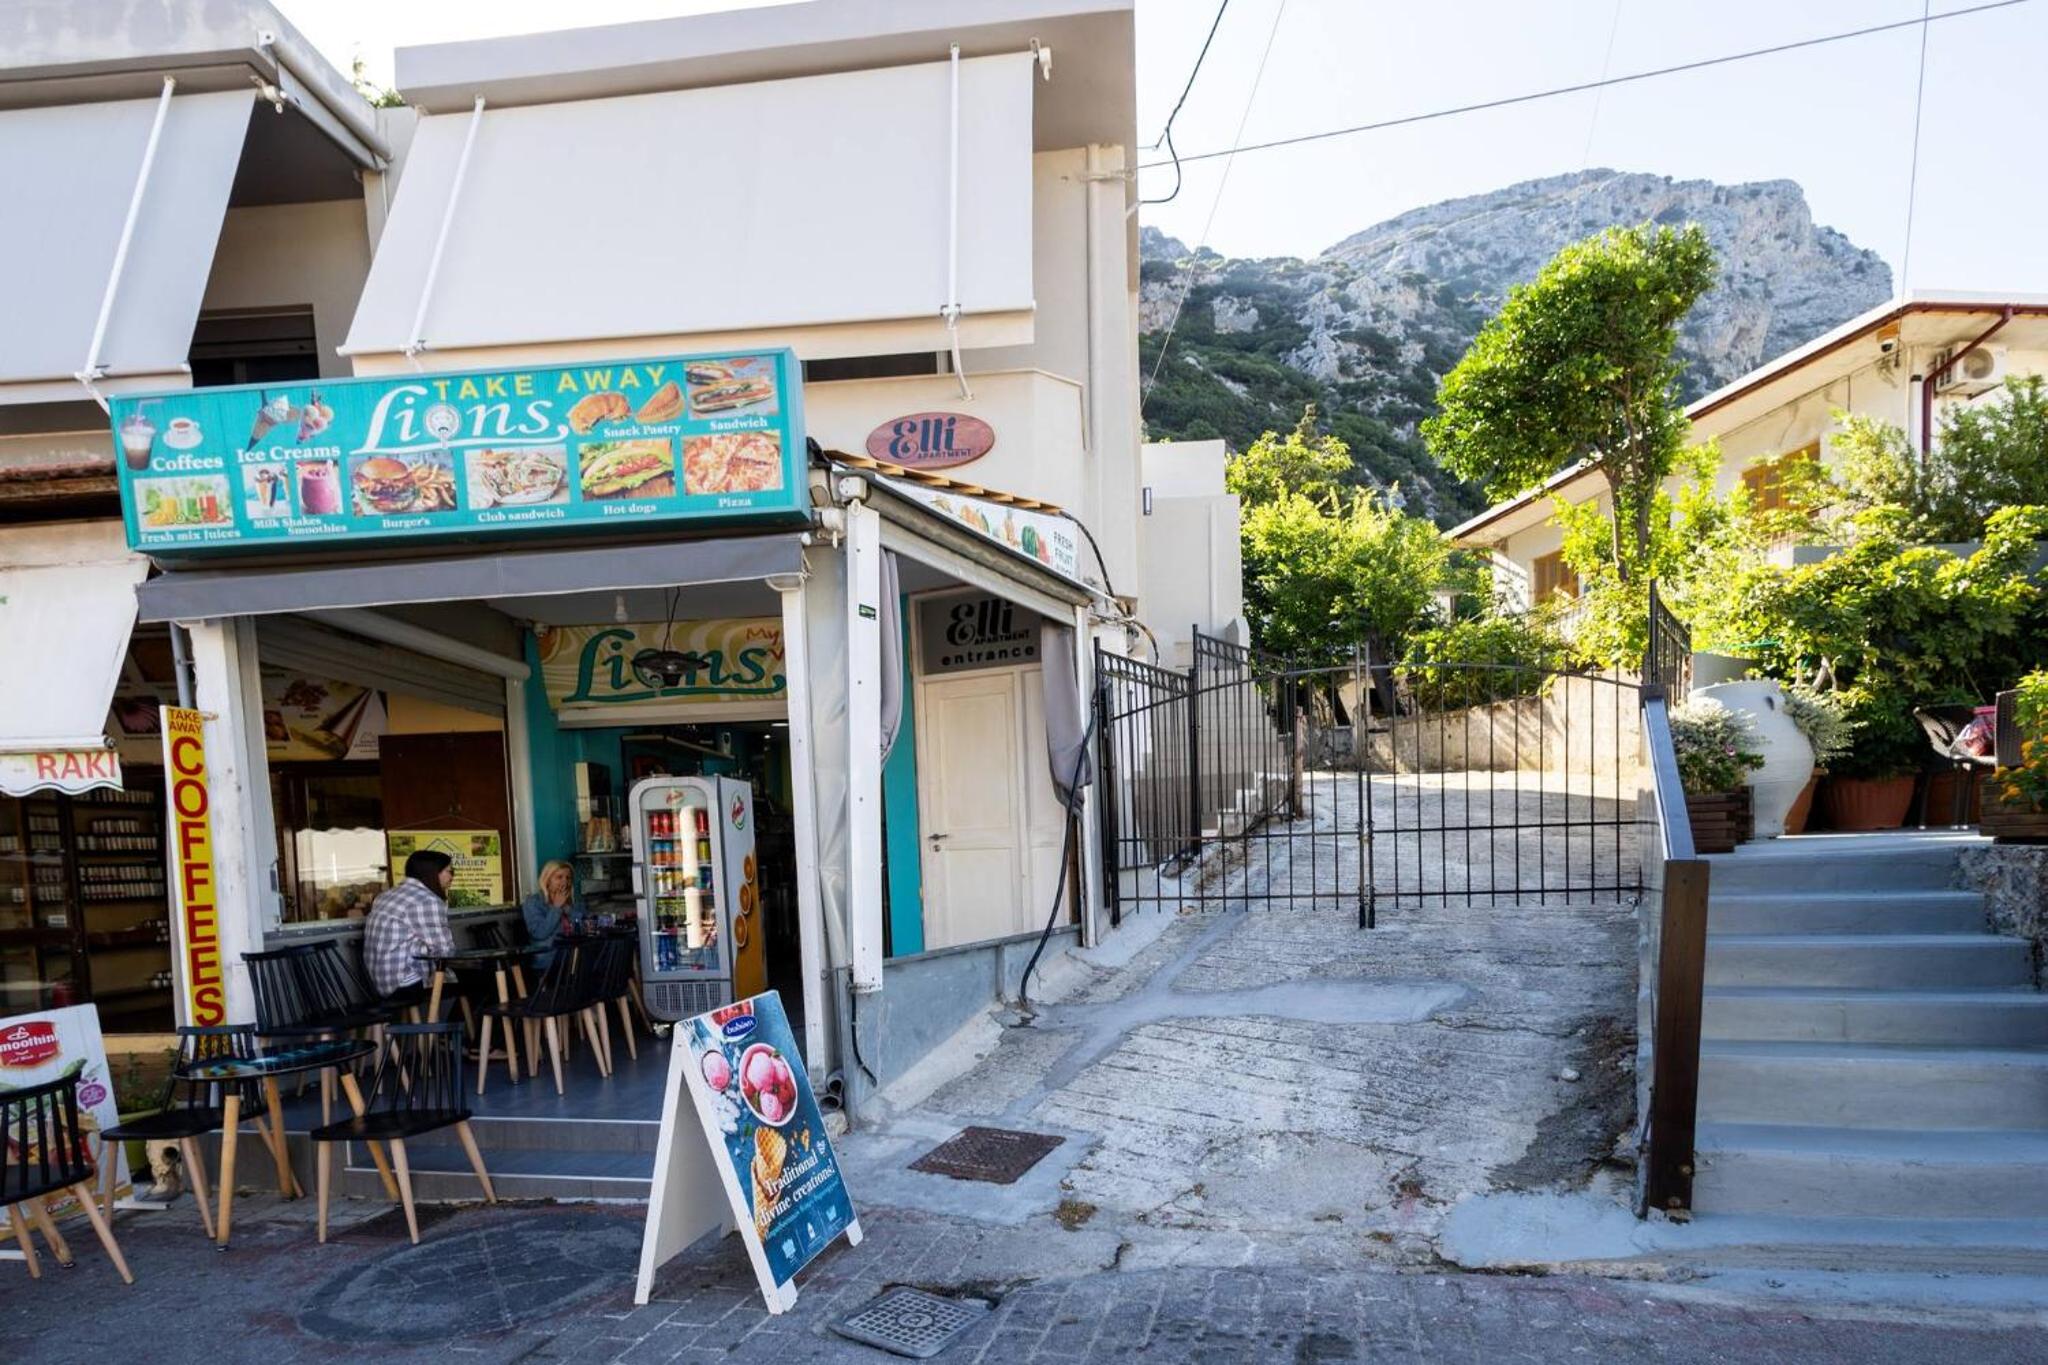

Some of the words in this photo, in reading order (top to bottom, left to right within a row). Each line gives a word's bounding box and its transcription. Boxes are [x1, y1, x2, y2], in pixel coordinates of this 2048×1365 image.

[433, 375, 534, 401] TAKE
[557, 365, 665, 393] AWAY
[710, 417, 768, 430] Sandwich
[603, 425, 640, 438] Snack
[888, 416, 957, 460] Elli
[153, 452, 223, 471] Coffees
[237, 448, 266, 463] Ice
[270, 445, 340, 461] Creams
[917, 448, 972, 460] APARTMENT
[603, 504, 627, 515] Hot
[630, 502, 656, 514] dogs
[719, 497, 752, 508] Pizza
[478, 510, 505, 522] Club
[508, 507, 565, 520] sandwich
[254, 518, 279, 529] Milk
[282, 516, 321, 528] Shakes
[288, 523, 347, 536] Smoothies
[383, 517, 431, 529] Burger's
[141, 531, 174, 544] Fresh
[176, 530, 200, 541] mix
[204, 529, 241, 542] Juices
[946, 599, 1013, 647] Elli
[974, 629, 1031, 646] APARTMENT
[941, 645, 1035, 666] entrance
[168, 709, 199, 722] TAKE
[170, 721, 202, 734] AWAY
[36, 751, 118, 780] RAKI
[172, 737, 224, 1027] COFFEES
[764, 1148, 819, 1197] Traditional
[756, 1194, 792, 1228] divine
[792, 1157, 835, 1202] creations!
